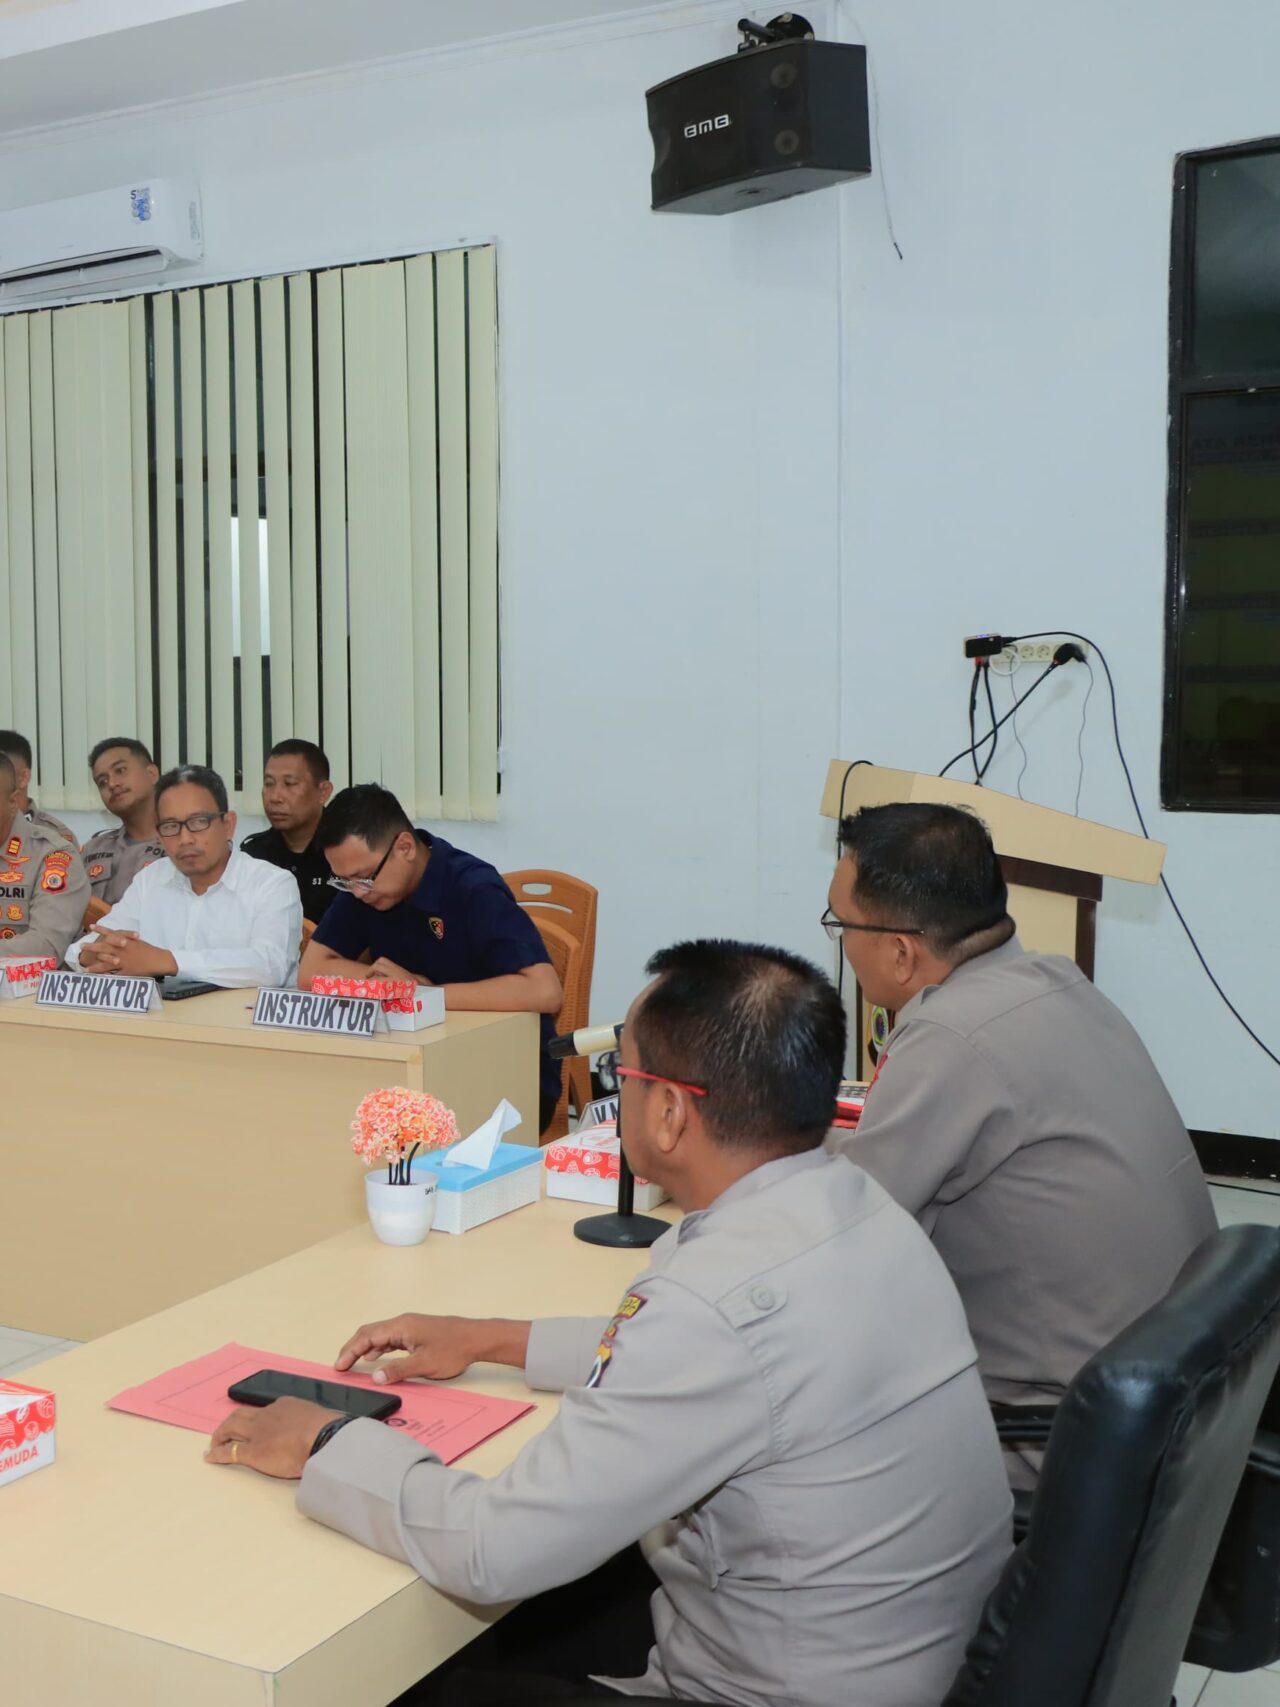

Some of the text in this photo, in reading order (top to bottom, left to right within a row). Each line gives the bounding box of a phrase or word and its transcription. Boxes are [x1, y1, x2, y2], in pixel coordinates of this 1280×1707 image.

[683, 113, 730, 138] BMB
[40, 973, 149, 1009] INSTRUKTUR
[257, 991, 375, 1033] INSTRUKTUR
